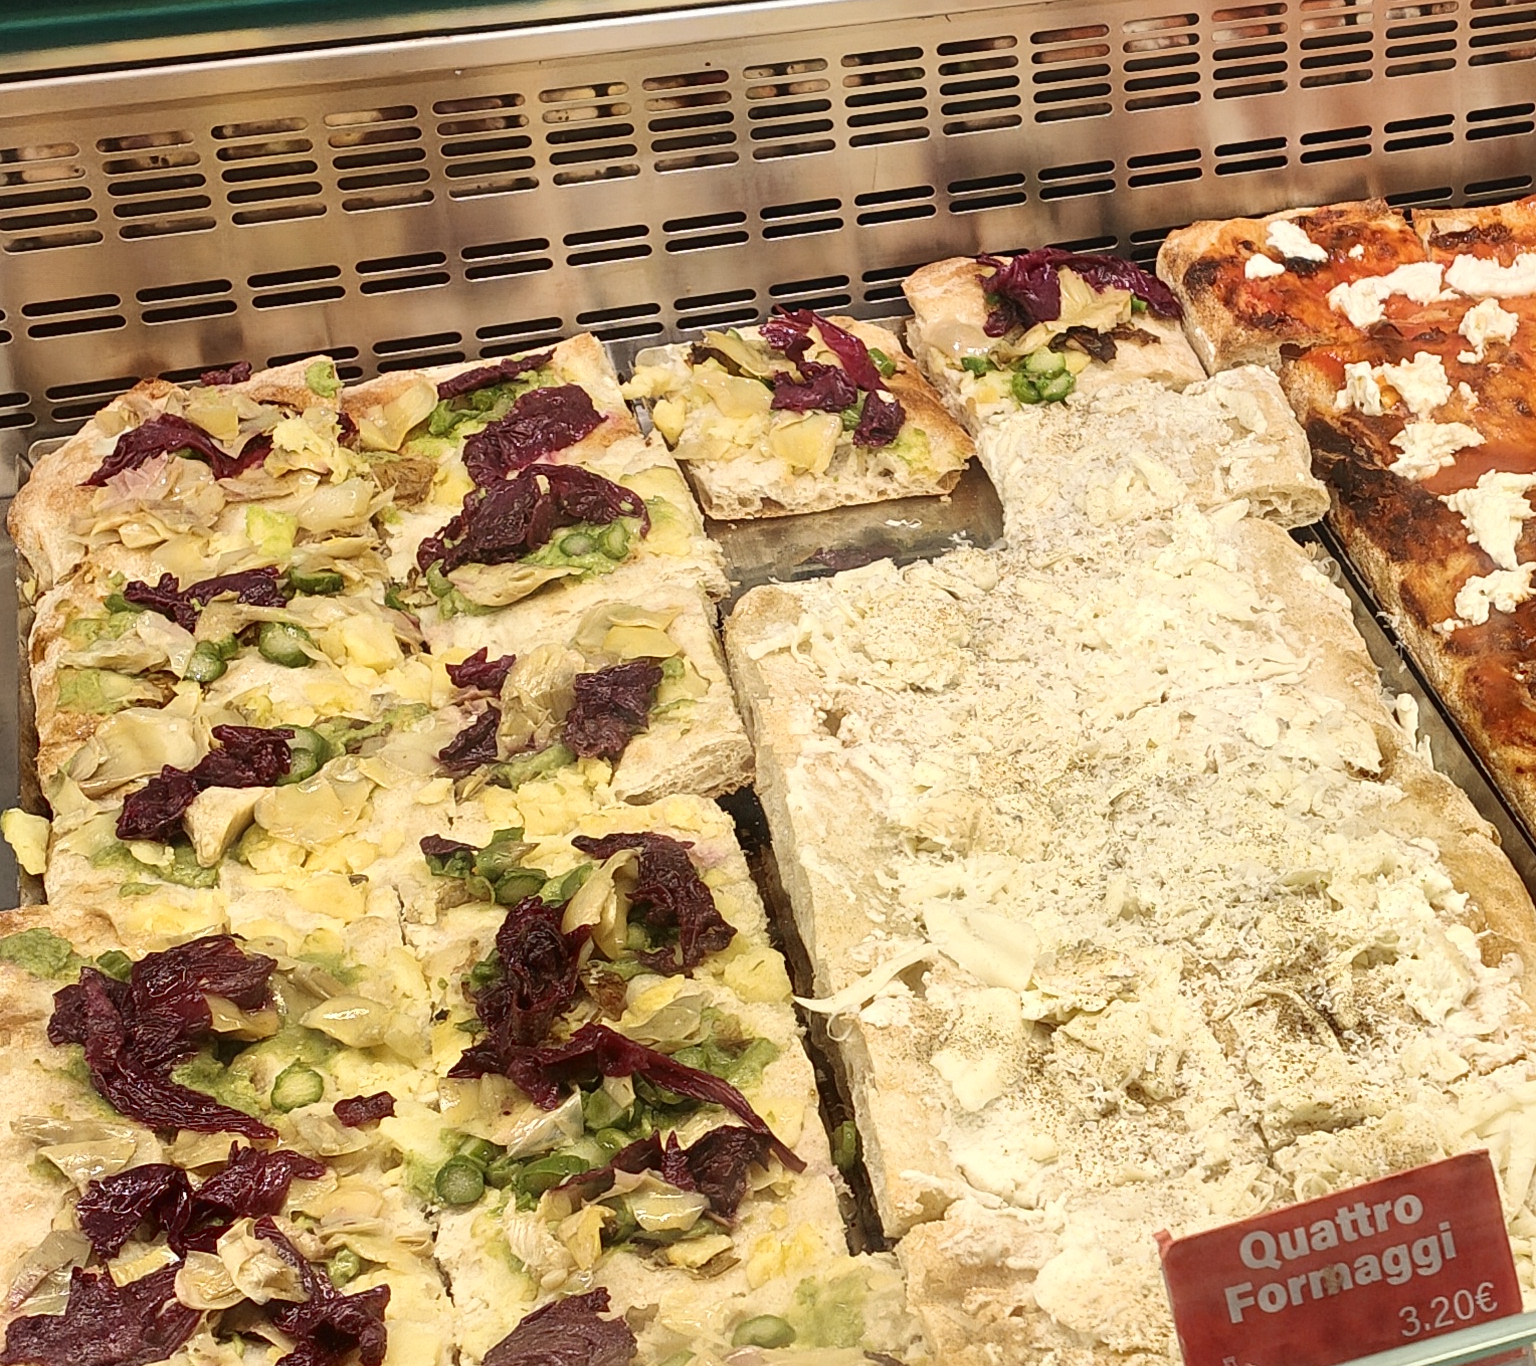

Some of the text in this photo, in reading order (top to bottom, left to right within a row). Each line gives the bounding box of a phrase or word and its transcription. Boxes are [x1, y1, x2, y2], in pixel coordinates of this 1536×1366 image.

[1239, 1194, 1424, 1271] Quattro
[1224, 1222, 1457, 1324] Formaggi
[1398, 1282, 1498, 1337] 3.20€
